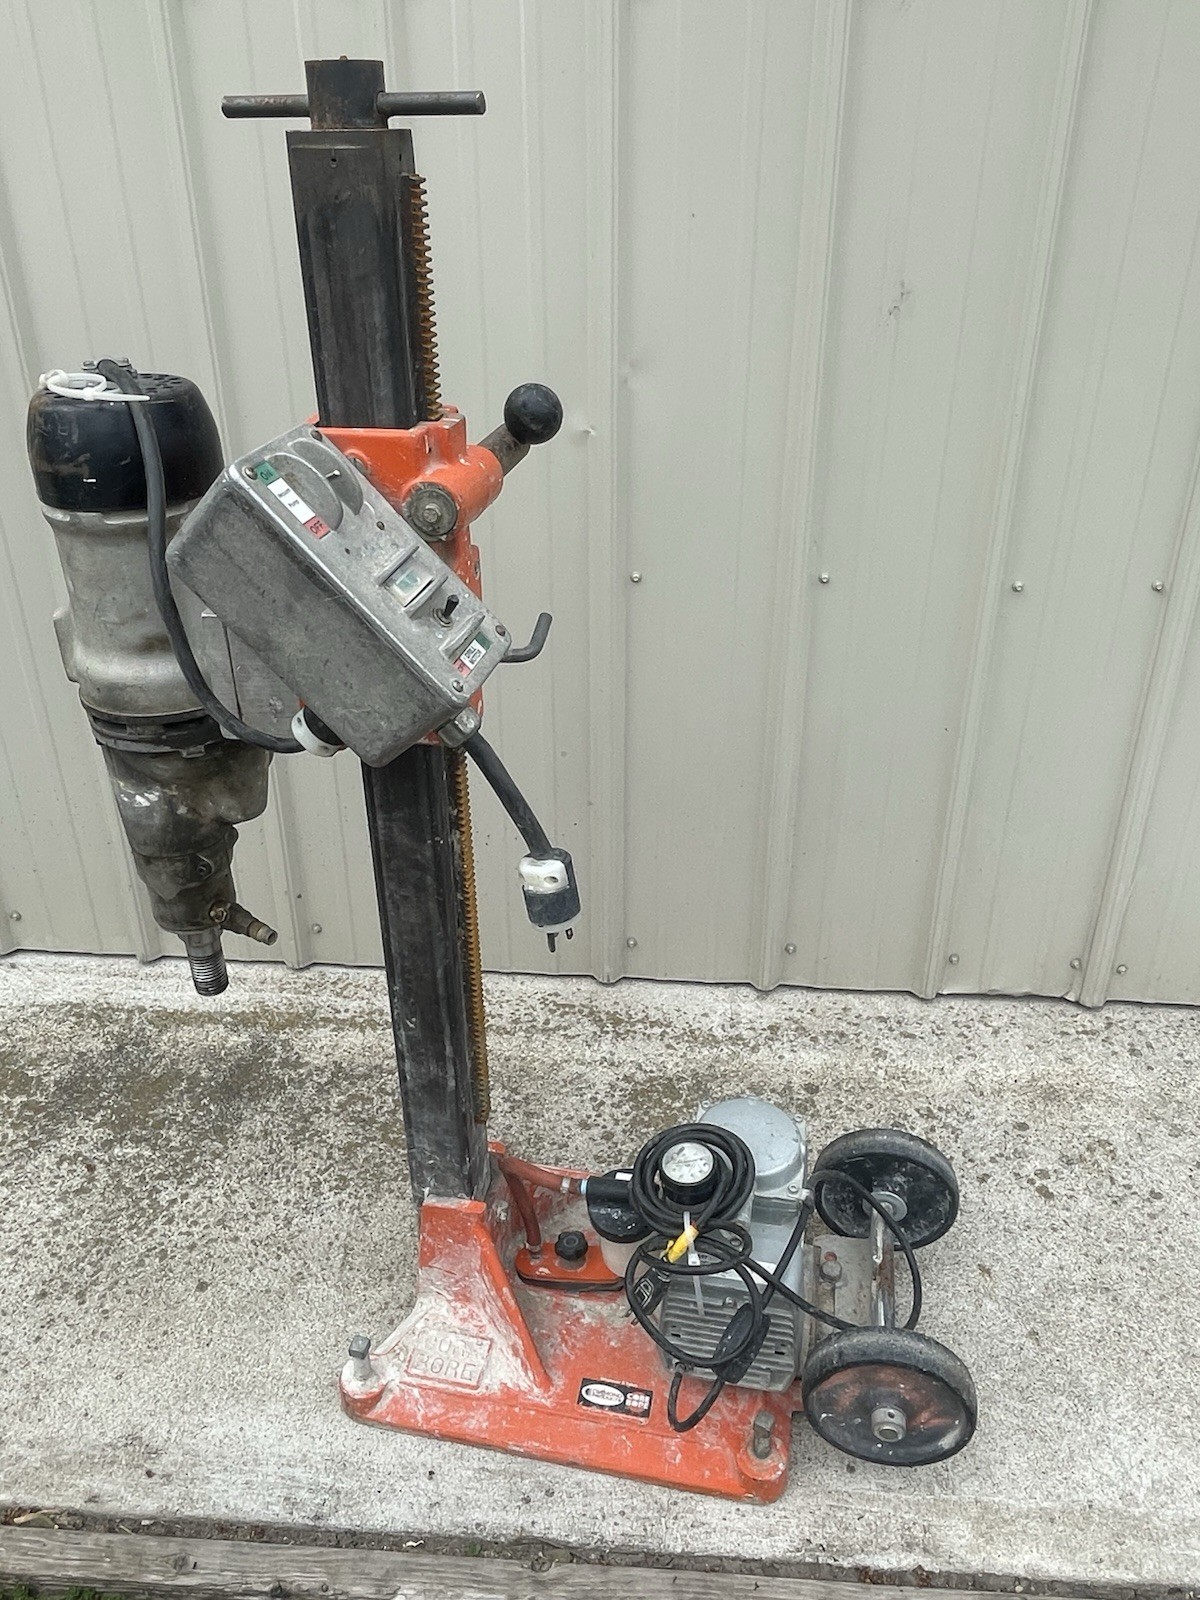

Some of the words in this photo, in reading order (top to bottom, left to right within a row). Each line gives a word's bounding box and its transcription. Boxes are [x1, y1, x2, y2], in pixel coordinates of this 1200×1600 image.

[260, 469, 274, 480] ON
[310, 520, 323, 534] OFF
[412, 1352, 478, 1382] BORE
